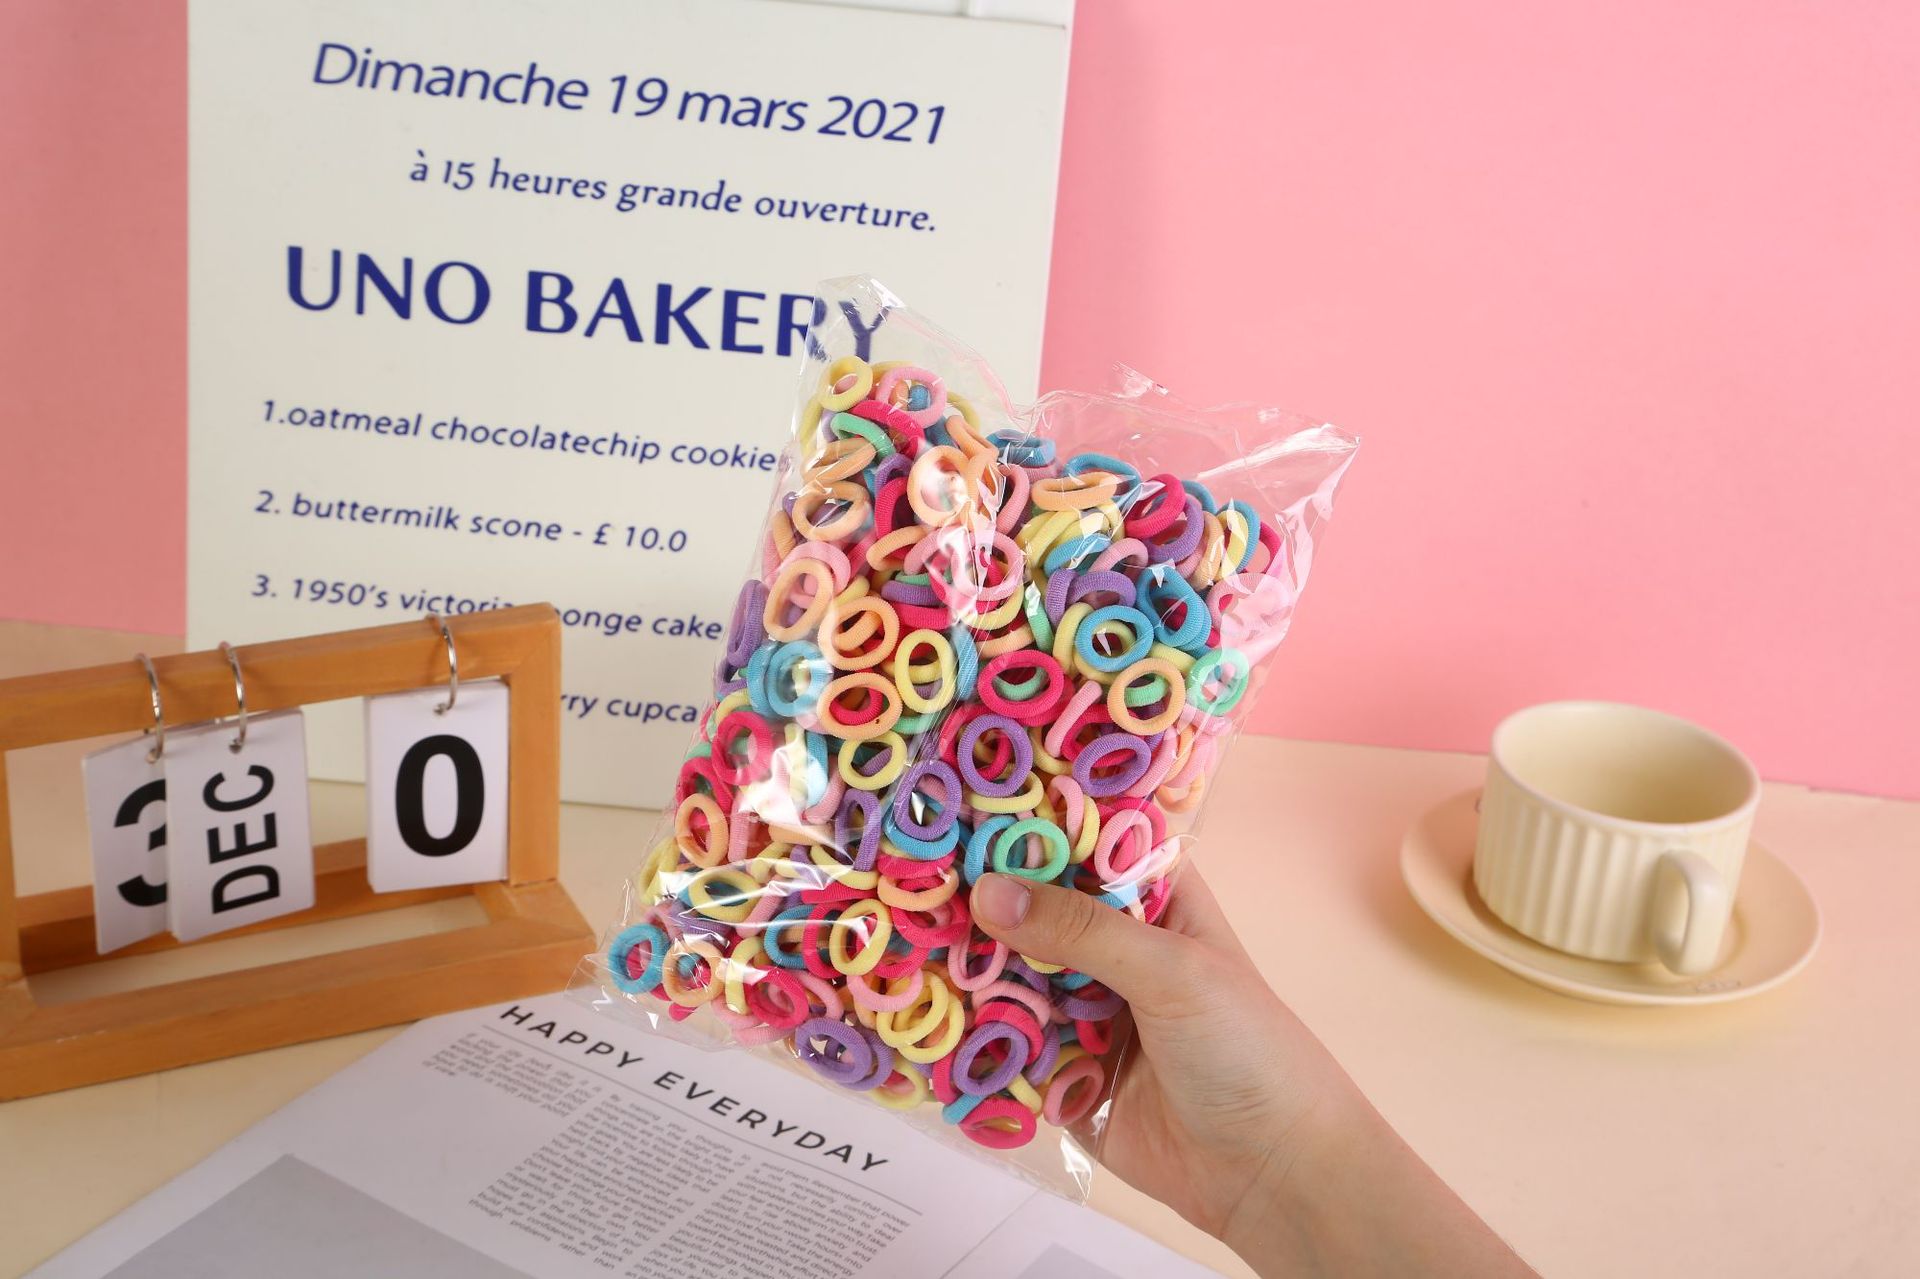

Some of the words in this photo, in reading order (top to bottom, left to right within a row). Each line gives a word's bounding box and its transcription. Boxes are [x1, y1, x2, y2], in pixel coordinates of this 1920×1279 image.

[312, 42, 590, 111] Dimanche
[610, 74, 669, 117] 19
[677, 90, 809, 132] mars
[816, 95, 947, 145] 2021
[409, 149, 429, 182] à
[443, 160, 475, 191] 15
[489, 156, 607, 200] heures
[615, 179, 743, 214] grande
[754, 196, 936, 232] ouverture.
[286, 244, 492, 326] UNO
[525, 269, 891, 363] BAKERY
[430, 419, 662, 464] chocolatechip
[671, 444, 789, 472] cookie
[254, 490, 281, 515] 2.
[292, 493, 460, 531] buttermilk
[470, 515, 562, 541] scone
[624, 526, 687, 553] 10.0
[252, 575, 278, 599] 3.
[652, 614, 723, 640] cake
[606, 698, 698, 724] cupca
[202, 765, 280, 914] DEC
[395, 734, 485, 857] 0
[500, 1005, 643, 1069] HAPPY
[652, 1071, 890, 1174] EVERYDAY
